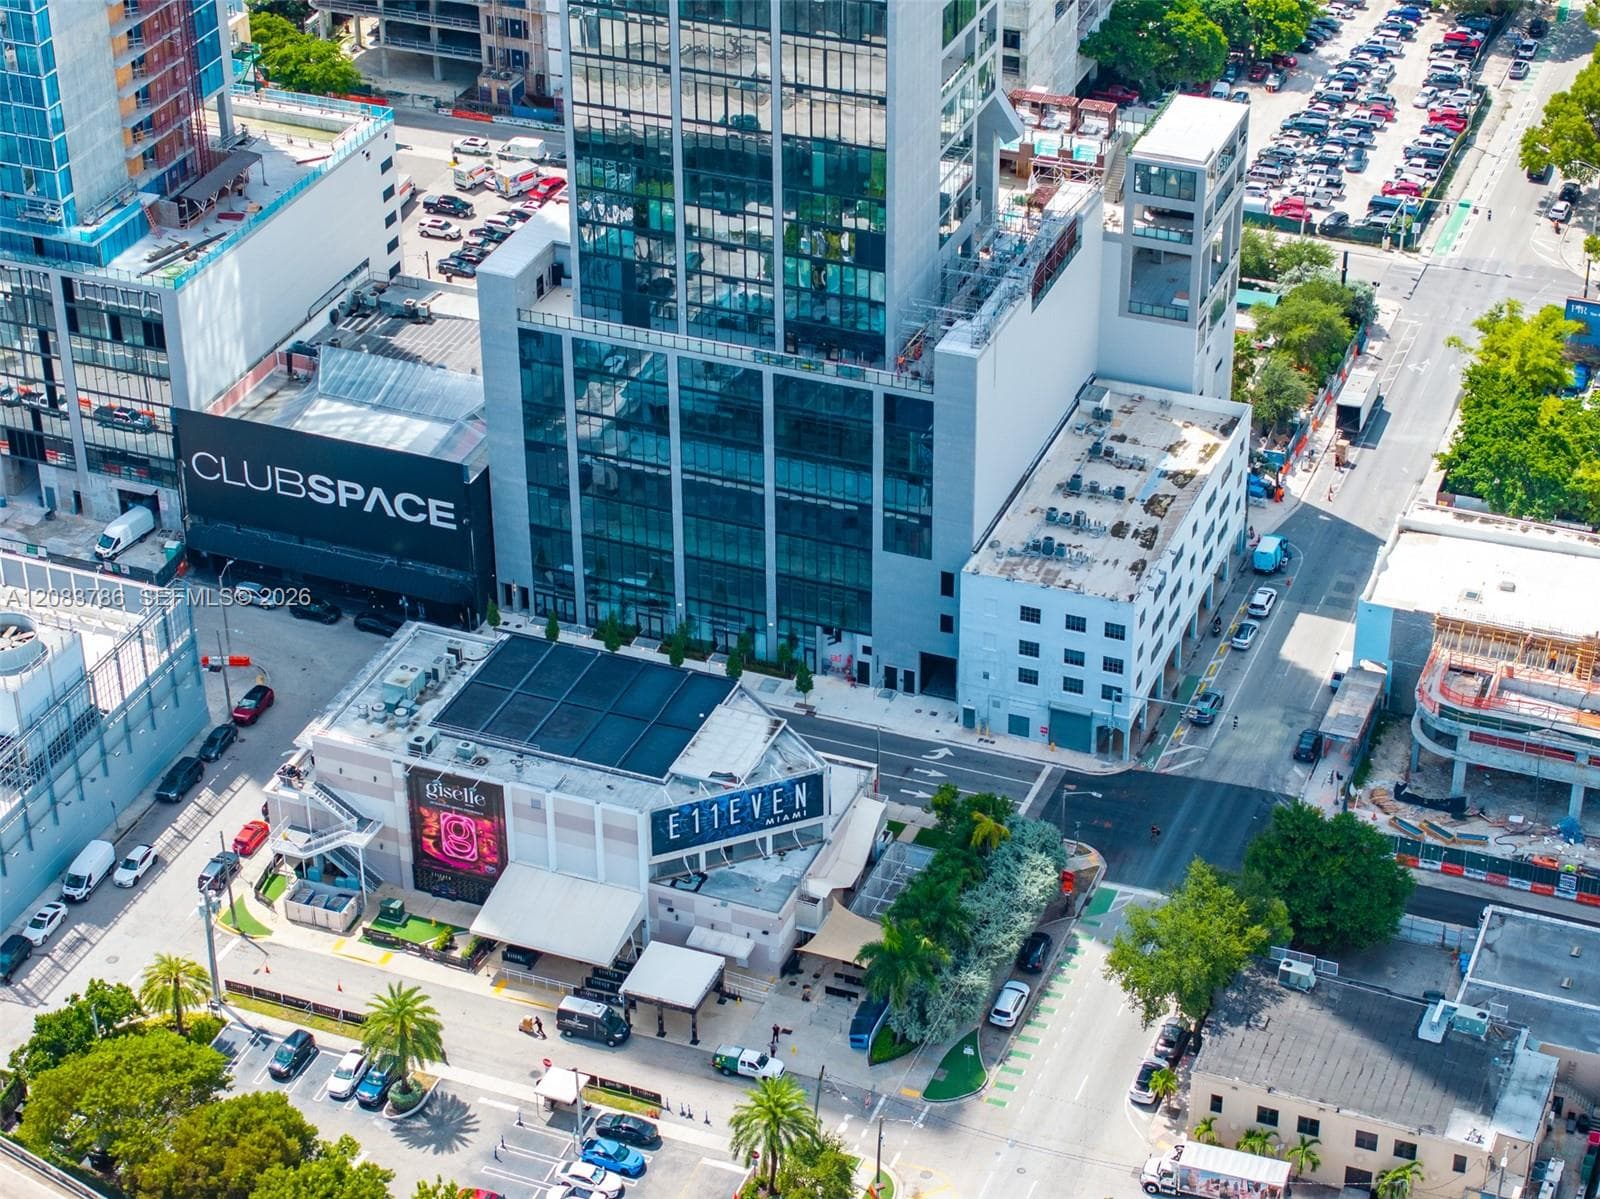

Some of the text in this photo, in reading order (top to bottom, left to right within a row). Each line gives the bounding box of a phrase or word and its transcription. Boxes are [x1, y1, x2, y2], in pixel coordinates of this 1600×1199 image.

[425, 783, 486, 807] giselle
[669, 782, 806, 839] E11EVEN
[765, 810, 807, 826] MIAMI
